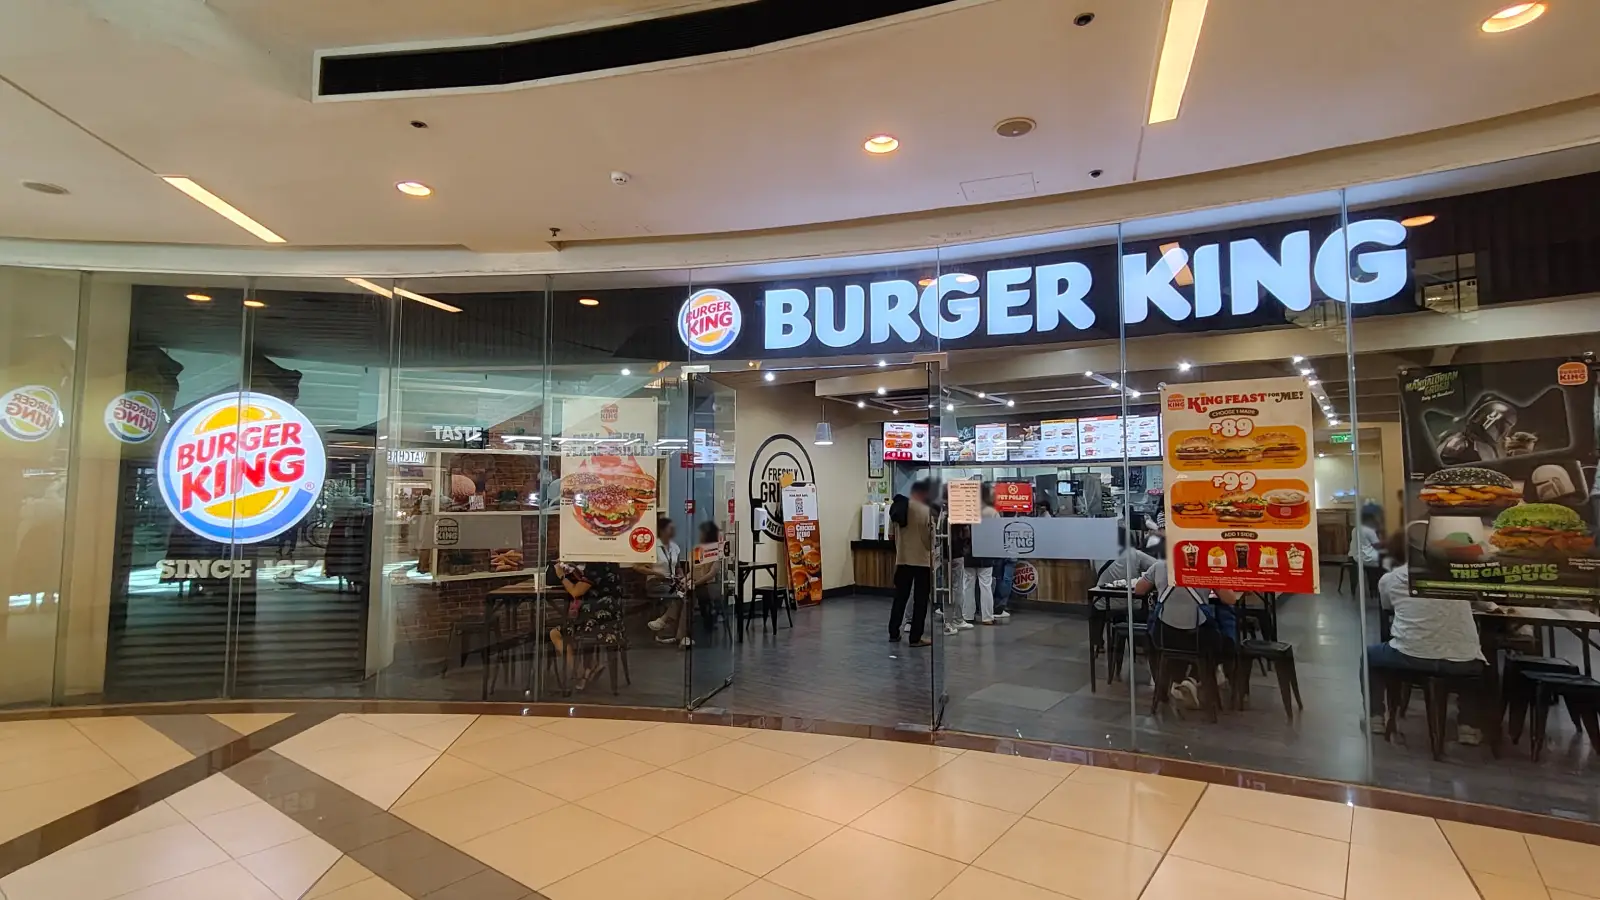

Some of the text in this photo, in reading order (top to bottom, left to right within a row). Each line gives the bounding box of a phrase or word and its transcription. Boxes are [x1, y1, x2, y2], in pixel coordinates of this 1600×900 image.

[765, 218, 1409, 350] BURGER KING
[685, 301, 731, 324] BURGER
[688, 312, 733, 336] KING
[1187, 393, 1223, 414] KING
[1225, 393, 1266, 405] FEAST
[432, 425, 483, 441] TASTE
[177, 422, 302, 472] BURGER
[182, 446, 305, 511] KING
[156, 559, 252, 579] SINCE
[1450, 563, 1558, 579] THE GALACTIC
[1504, 572, 1559, 583] DUO
